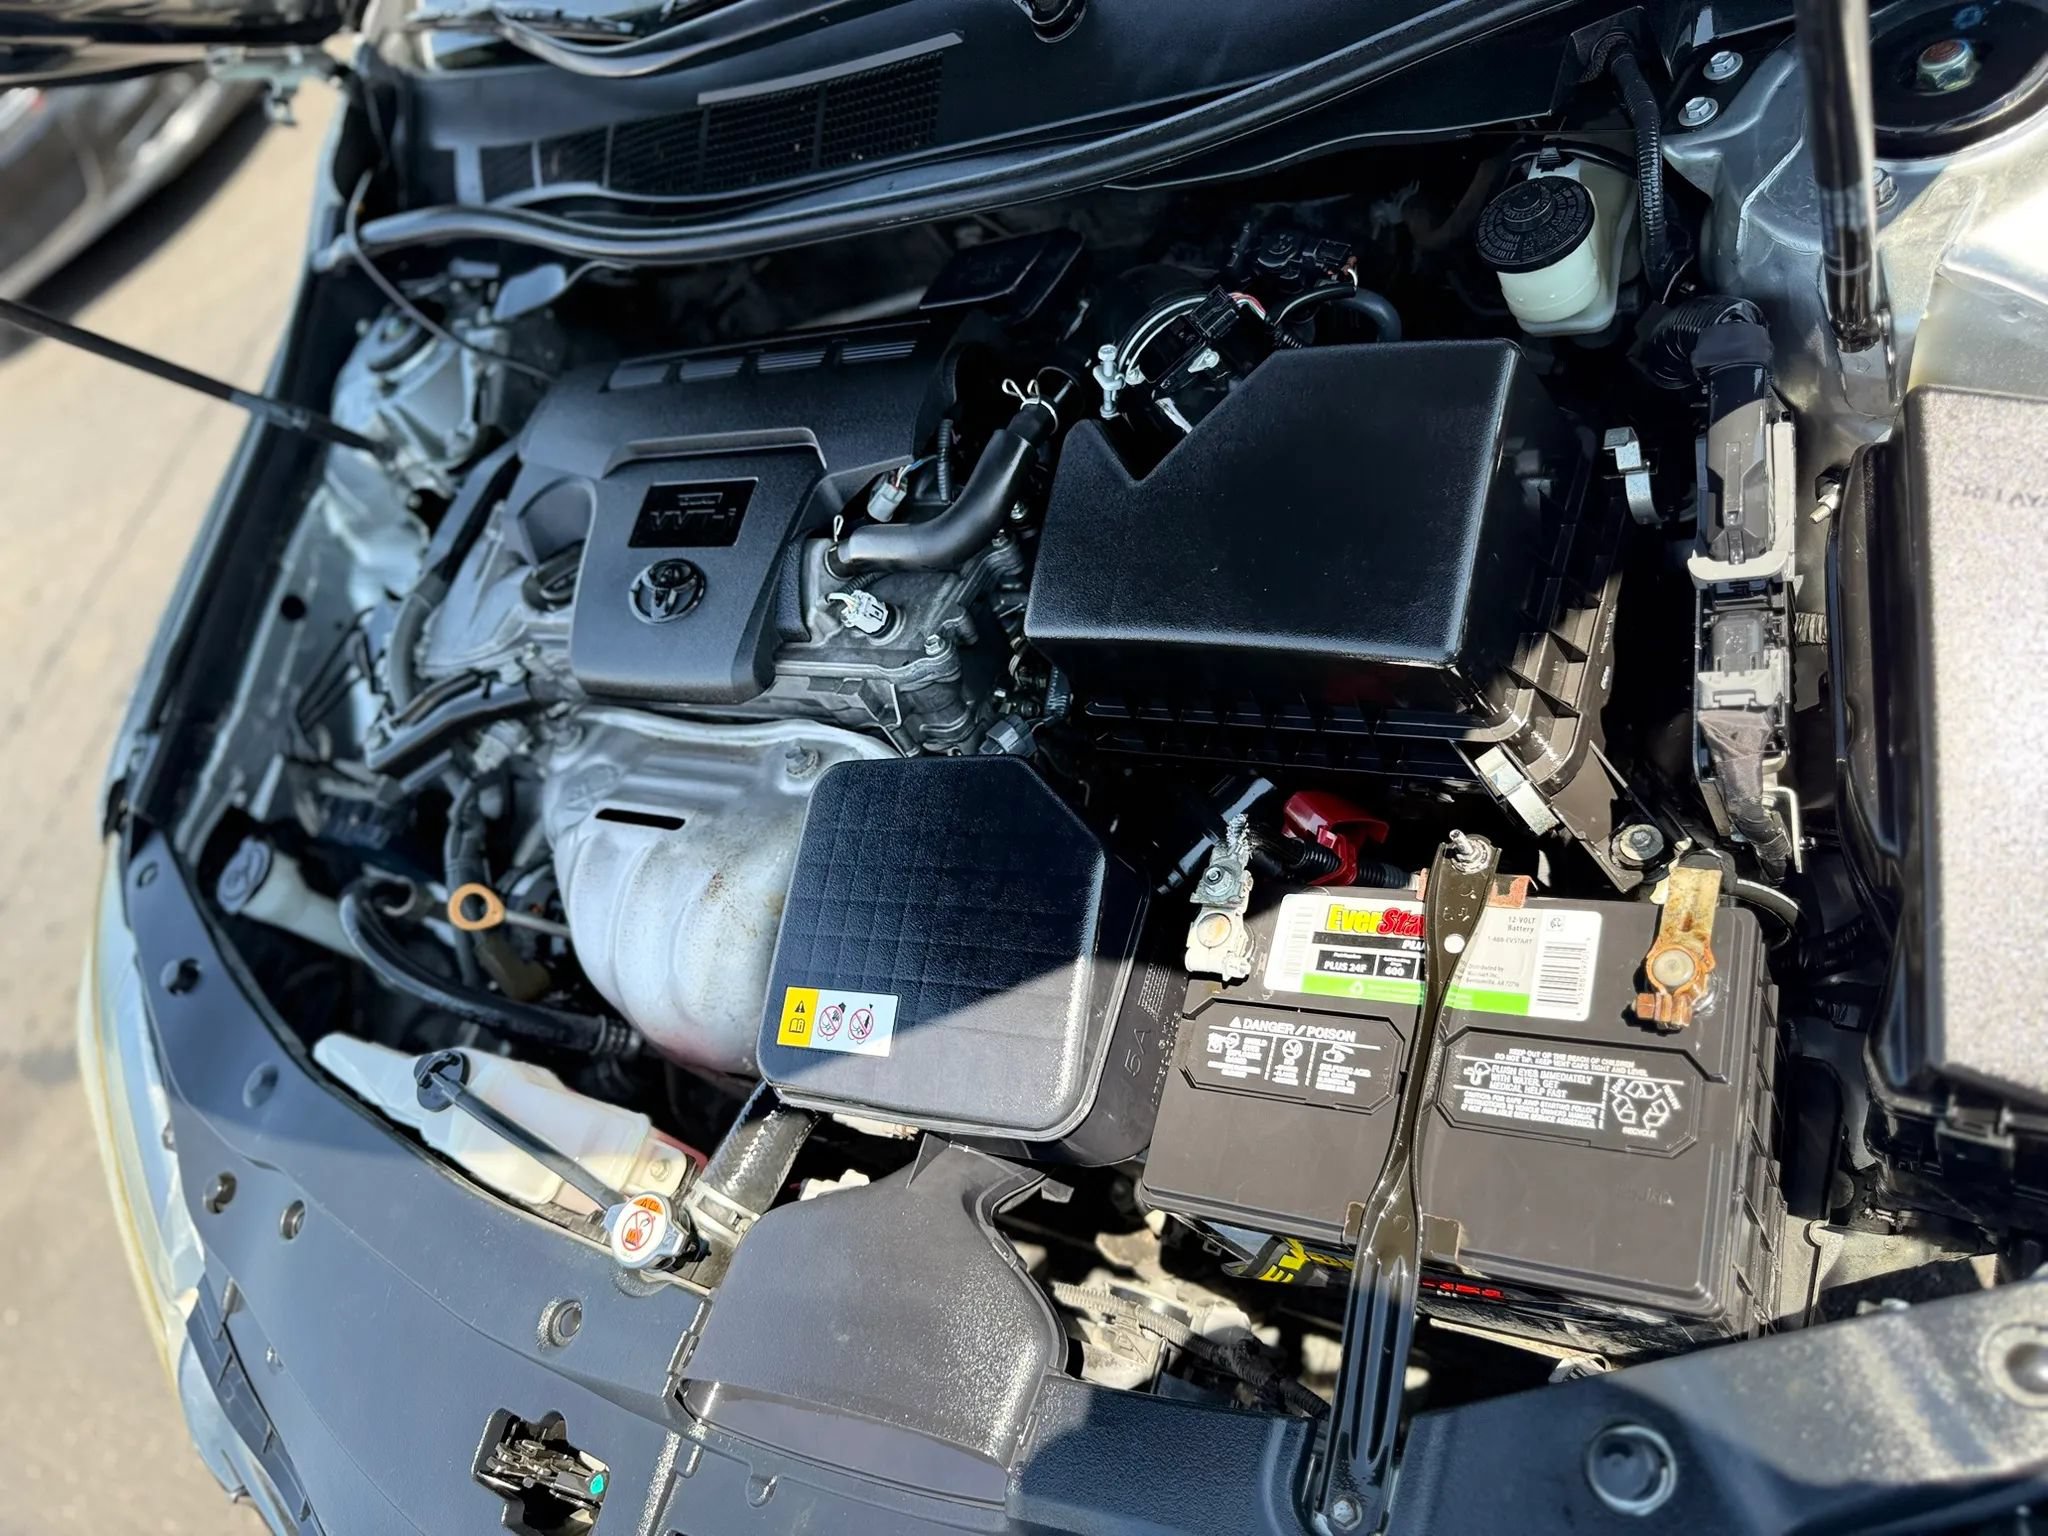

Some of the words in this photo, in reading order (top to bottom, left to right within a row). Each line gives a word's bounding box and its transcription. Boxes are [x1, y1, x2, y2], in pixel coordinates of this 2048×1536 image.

[1325, 904, 1425, 937] EverSta
[1401, 940, 1425, 951] PLU
[1323, 960, 1350, 972] PLUS
[1243, 1018, 1295, 1035] DANGER
[1306, 1026, 1357, 1043] POISON
[1495, 1052, 1505, 1060] DO
[1505, 1054, 1520, 1062] NOT
[1553, 1059, 1571, 1068] VENT
[1571, 1062, 1589, 1070] CAPS
[1611, 1066, 1626, 1074] AND
[1553, 1053, 1567, 1061] THE
[1567, 1054, 1590, 1063] REACH
[1601, 1058, 1635, 1068] CHILDREN
[1491, 1064, 1517, 1075] FLUSH
[1518, 1067, 1539, 1078] EYES
[1540, 1070, 1593, 1085] IMMEDIATELY
[1491, 1073, 1511, 1083] WITH
[1542, 1079, 1560, 1089] GET
[1489, 1080, 1522, 1093] MEDICAL
[1524, 1085, 1546, 1096] HELP
[1546, 1088, 1568, 1098] FAST
[1540, 1100, 1570, 1111] STARTING
[1571, 1104, 1598, 1115] FOLLOW
[1622, 1126, 1658, 1138] RECYCLE
